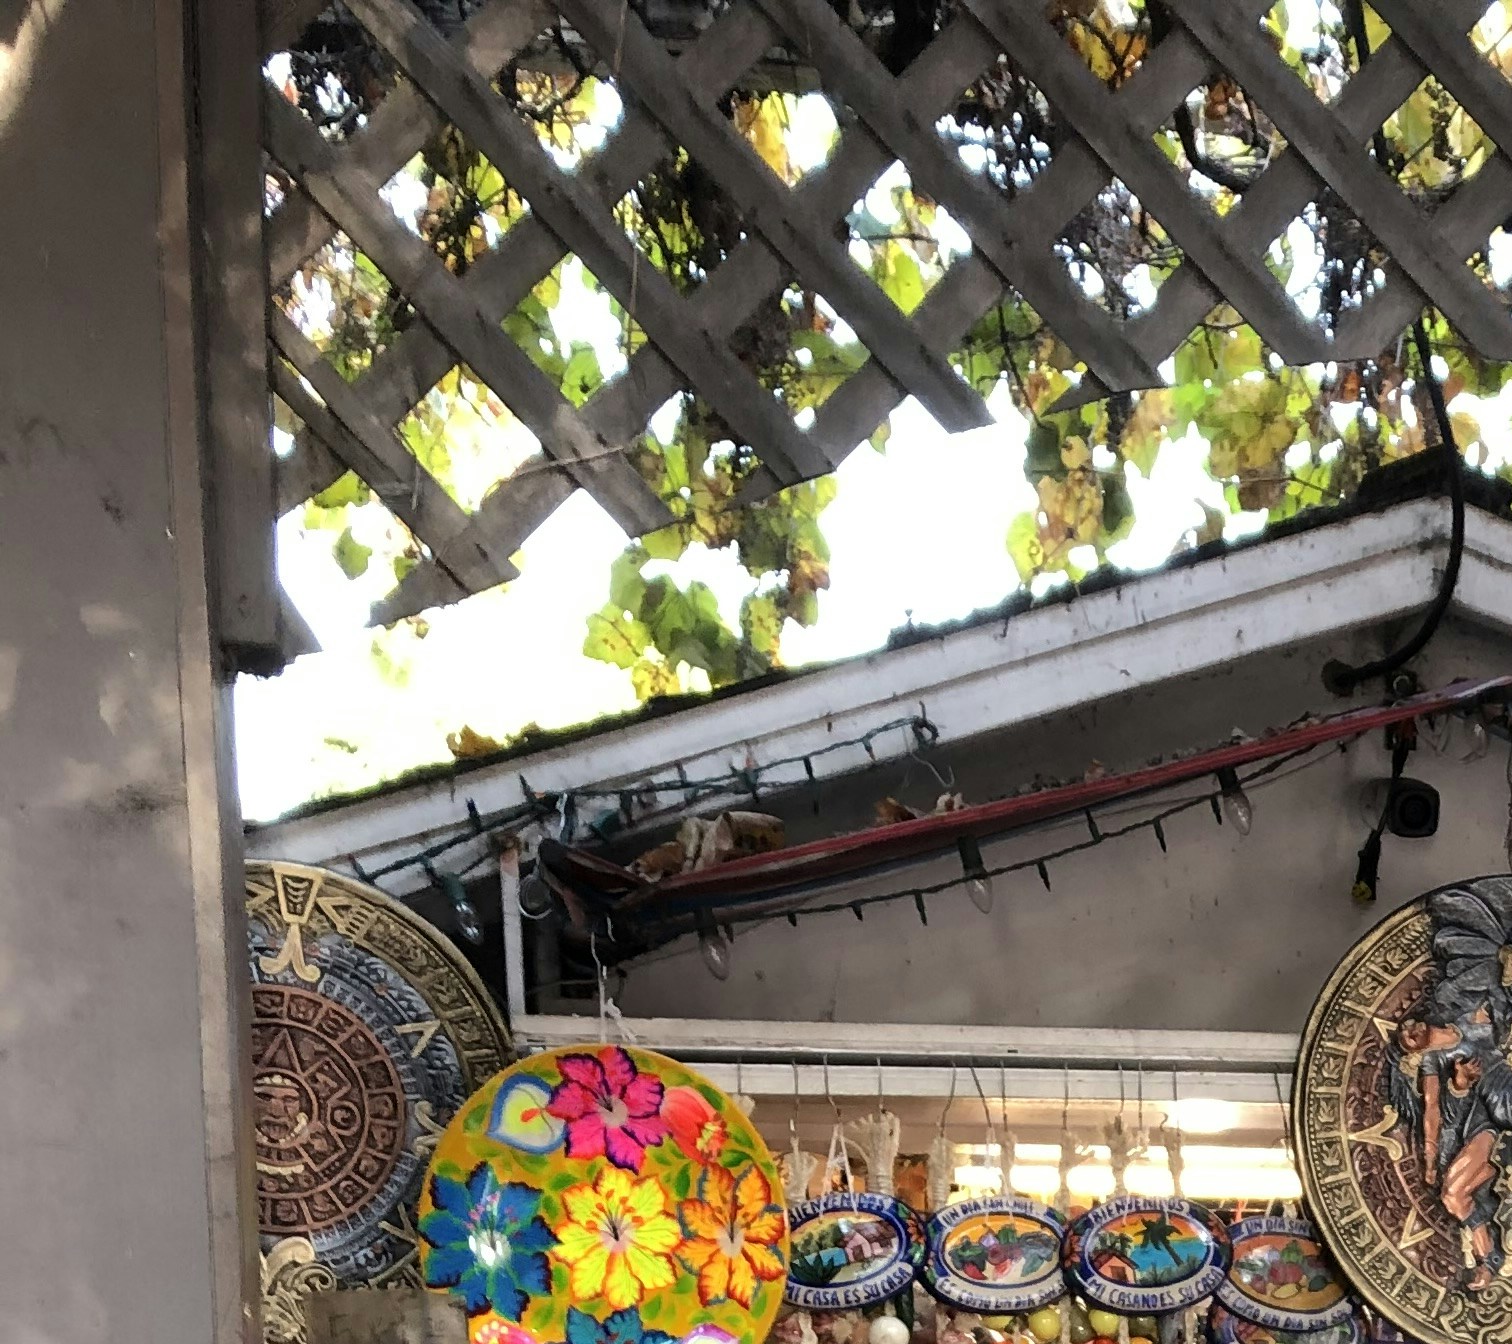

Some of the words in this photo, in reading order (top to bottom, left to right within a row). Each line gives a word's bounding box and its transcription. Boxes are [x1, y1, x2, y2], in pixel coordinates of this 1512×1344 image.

[804, 1288, 840, 1306] CASA
[844, 1289, 861, 1304] ES
[863, 1283, 879, 1300] SU
[880, 1266, 912, 1294] CASA
